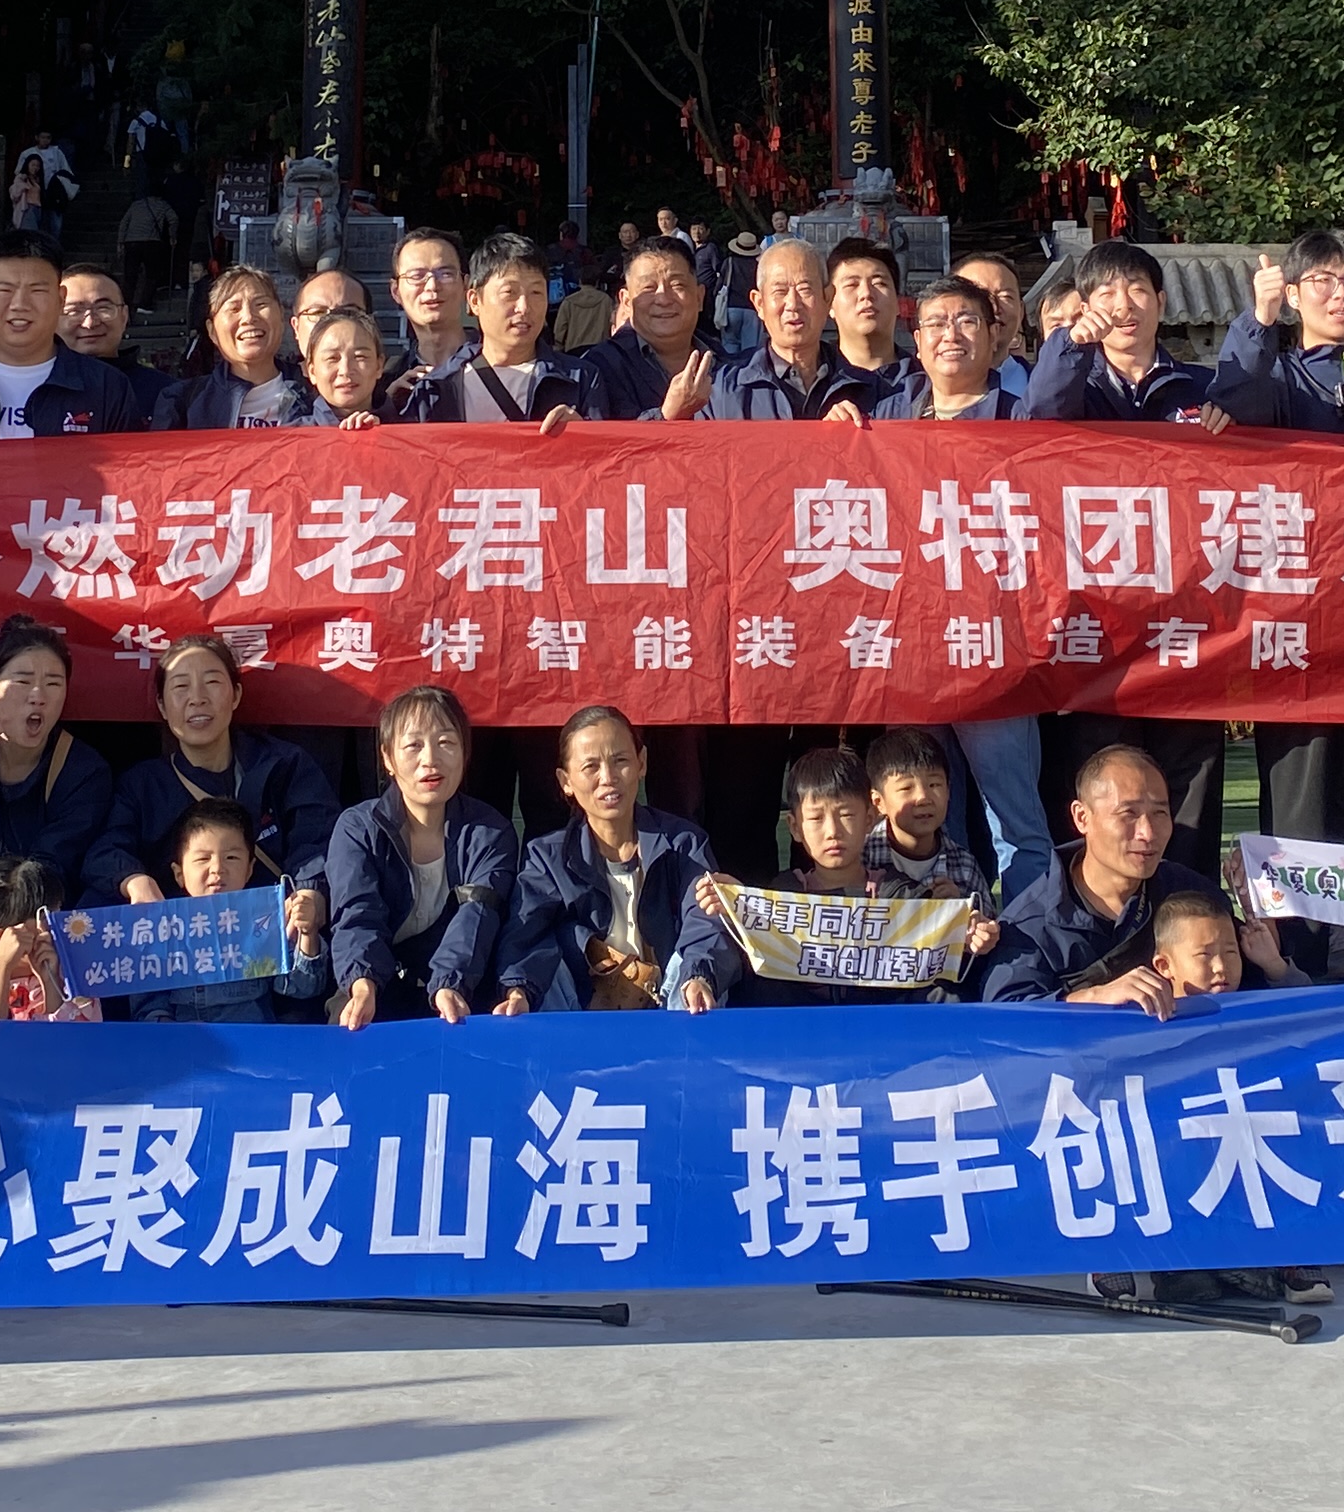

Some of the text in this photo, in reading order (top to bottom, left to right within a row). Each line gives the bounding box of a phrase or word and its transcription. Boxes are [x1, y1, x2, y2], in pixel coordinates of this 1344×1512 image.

[101, 907, 241, 949] 并肩的未来
[733, 894, 890, 941] 携手同行
[84, 943, 244, 987] 必将闪闪发光
